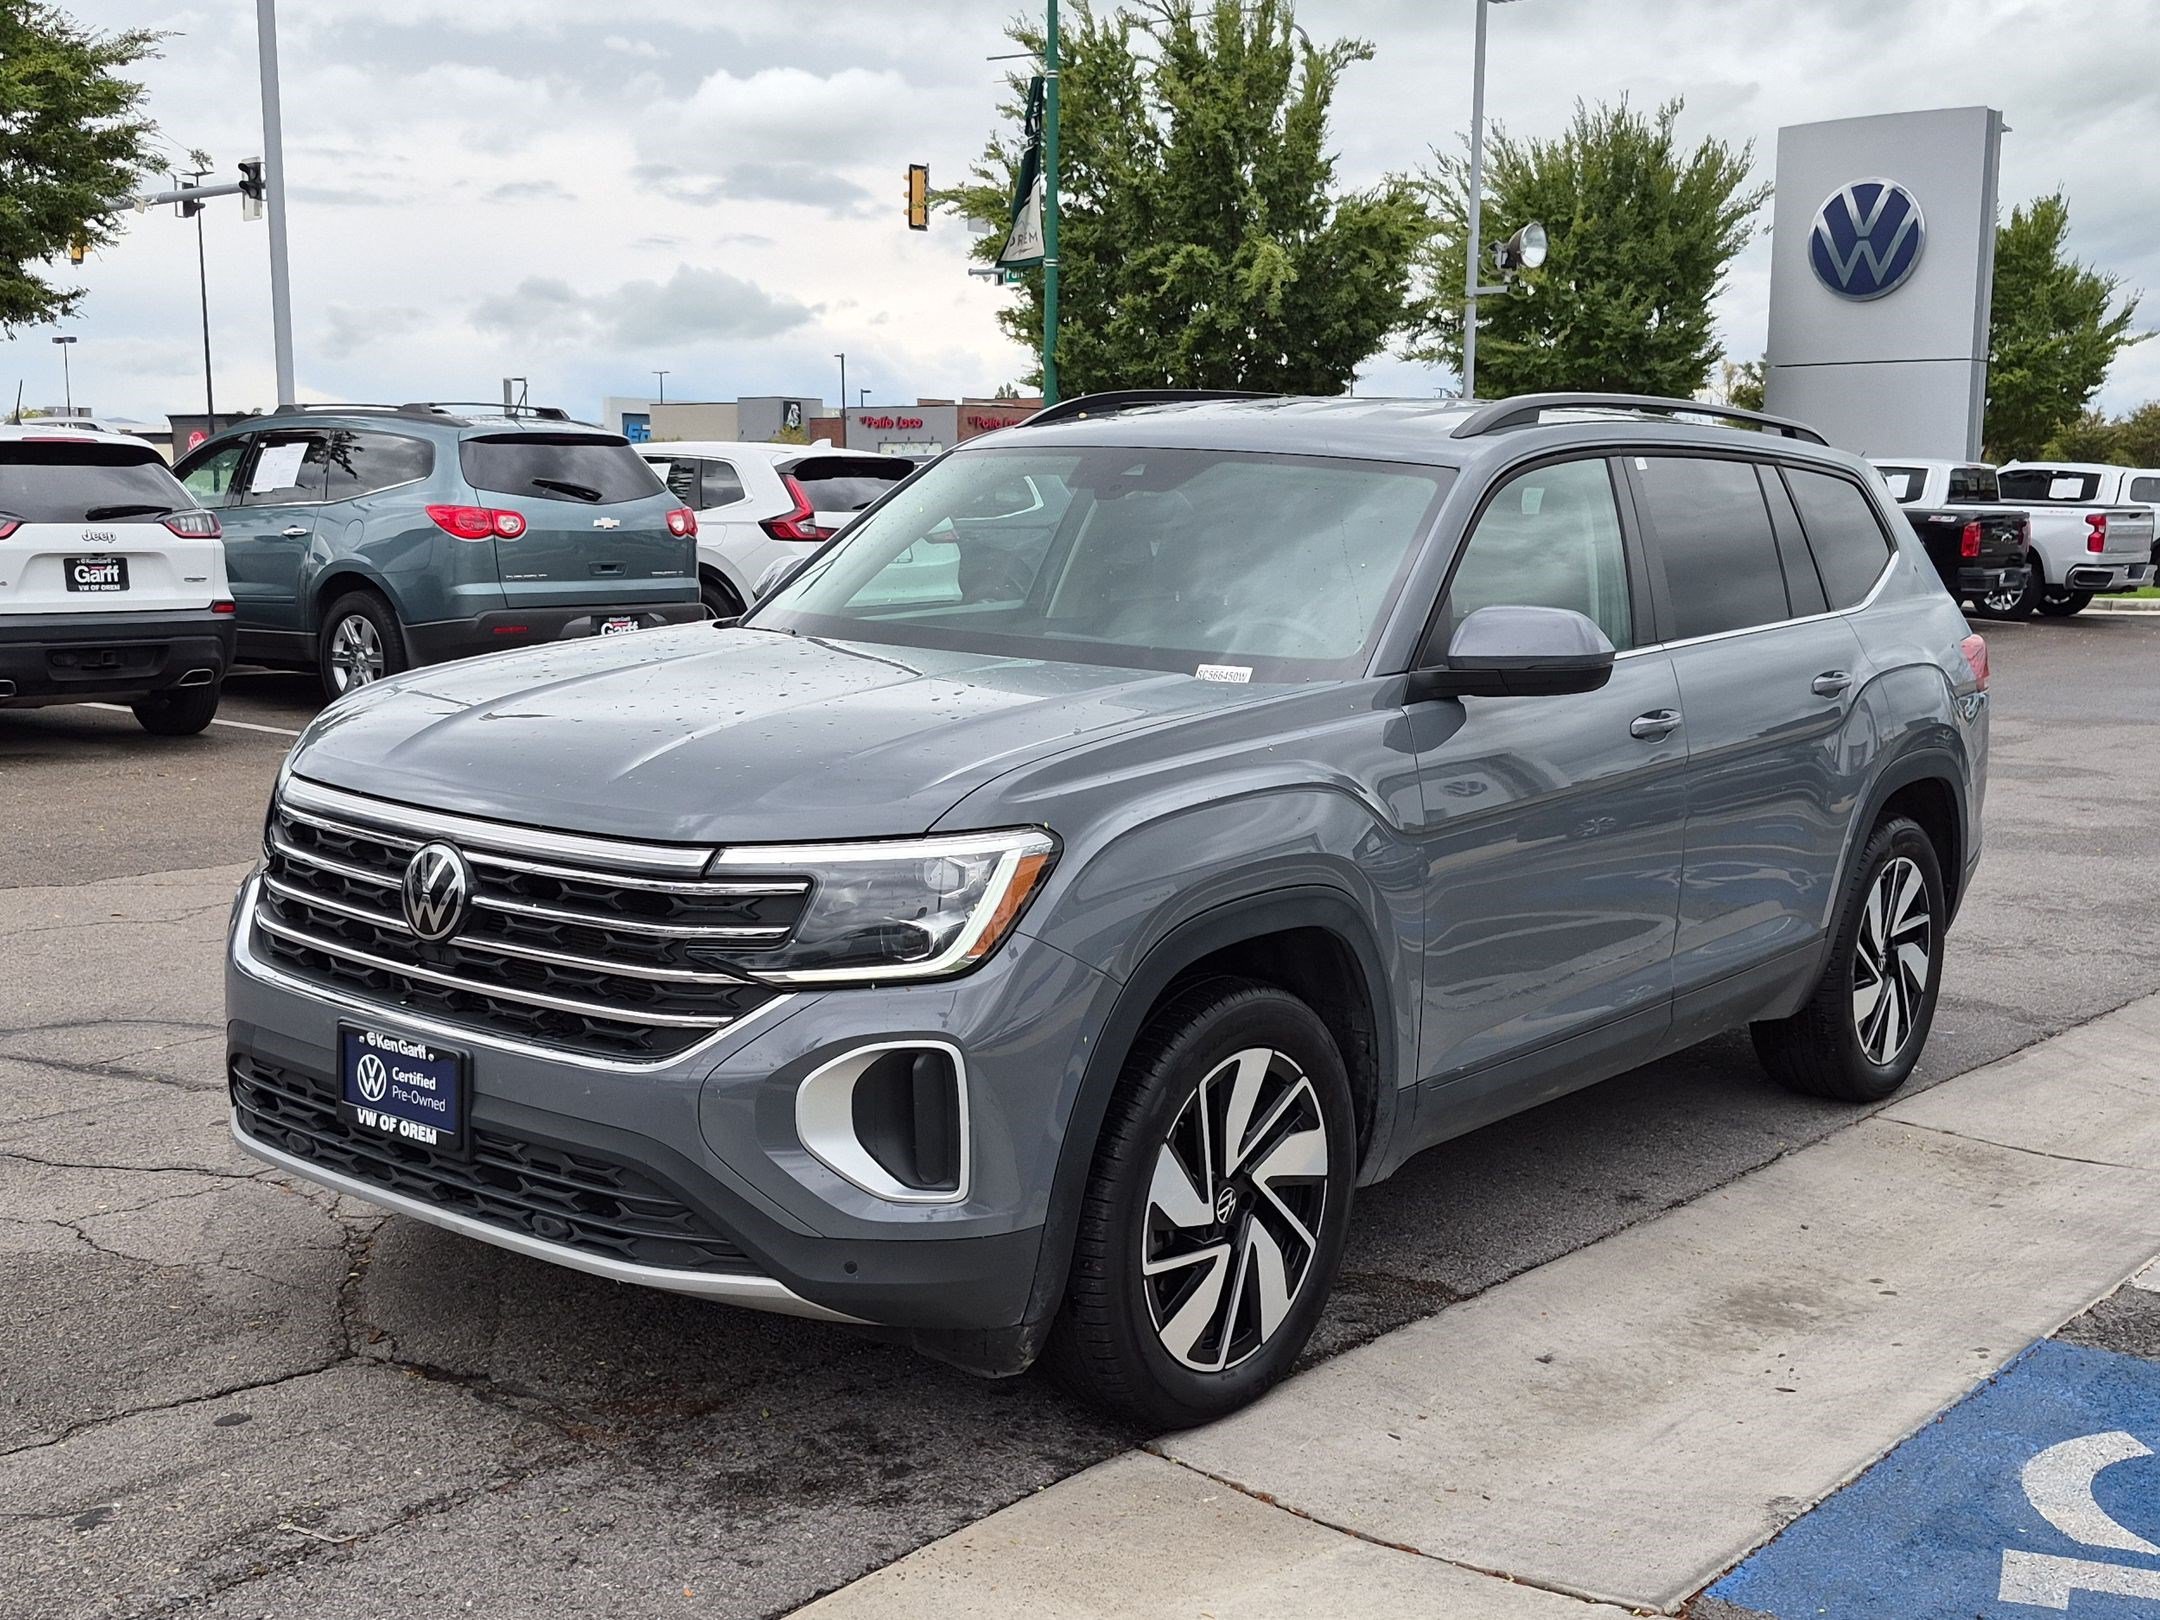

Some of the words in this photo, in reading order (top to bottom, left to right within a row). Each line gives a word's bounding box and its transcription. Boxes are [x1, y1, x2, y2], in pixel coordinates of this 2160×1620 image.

[1811, 180, 1922, 296] VW
[82, 529, 117, 544] Jeep
[74, 564, 120, 583] Garff
[392, 1066, 436, 1091] Certified
[392, 1085, 446, 1112] Pre-Owned
[357, 1107, 378, 1128] VW
[379, 1114, 397, 1133] OF
[400, 1120, 437, 1145] OREM
